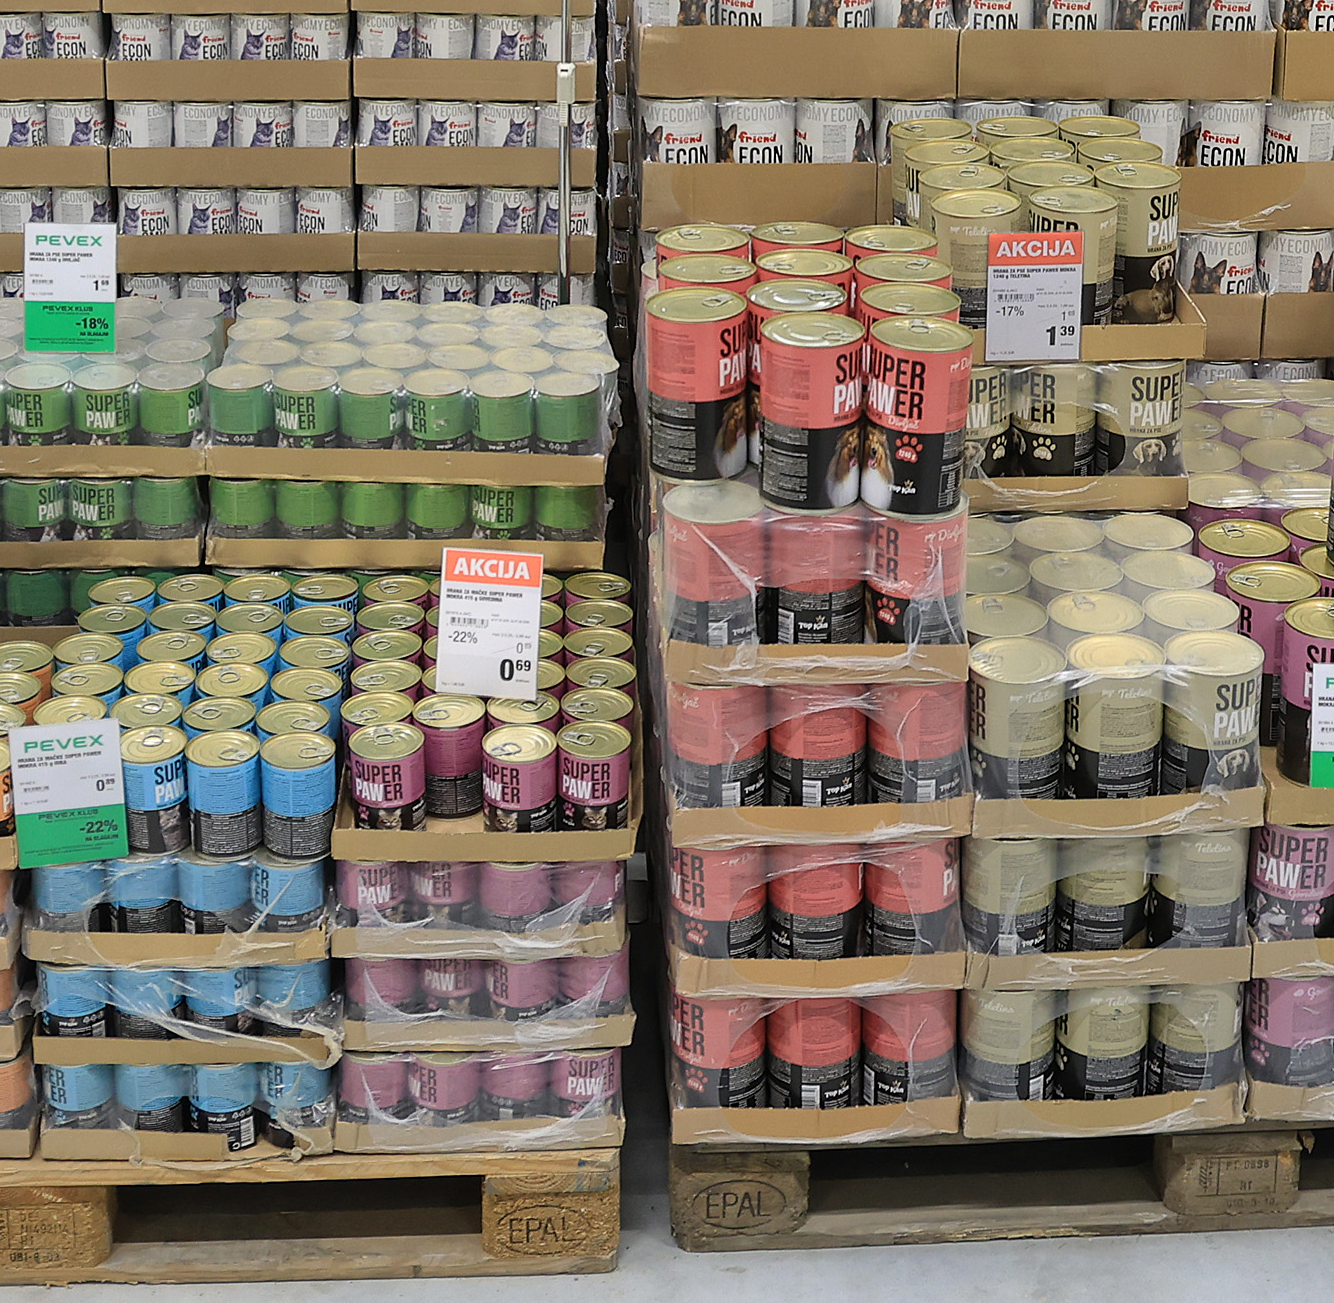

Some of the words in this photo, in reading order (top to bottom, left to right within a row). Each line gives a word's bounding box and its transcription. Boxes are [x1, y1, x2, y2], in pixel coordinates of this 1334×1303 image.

[35, 235, 102, 246] PEVEX
[996, 240, 1076, 257] AKCIJA
[93, 280, 99, 291] 1
[996, 306, 1024, 316] -17%
[75, 317, 109, 329] -18%
[1046, 326, 1056, 345] 1
[1060, 325, 1075, 336] 39
[453, 557, 530, 580] AKCIJA
[448, 630, 477, 644] -22%
[500, 658, 514, 681] 0
[515, 660, 531, 671] 69
[24, 734, 104, 753] PEVEX
[354, 759, 402, 784] SUPER
[96, 779, 105, 792] 0
[354, 780, 403, 801] PAWER
[79, 820, 118, 834] -22%
[1258, 828, 1329, 863] SUPER
[1255, 853, 1326, 889] PAWER
[704, 1190, 771, 1220] EPAL
[509, 1212, 571, 1246] EPAL
